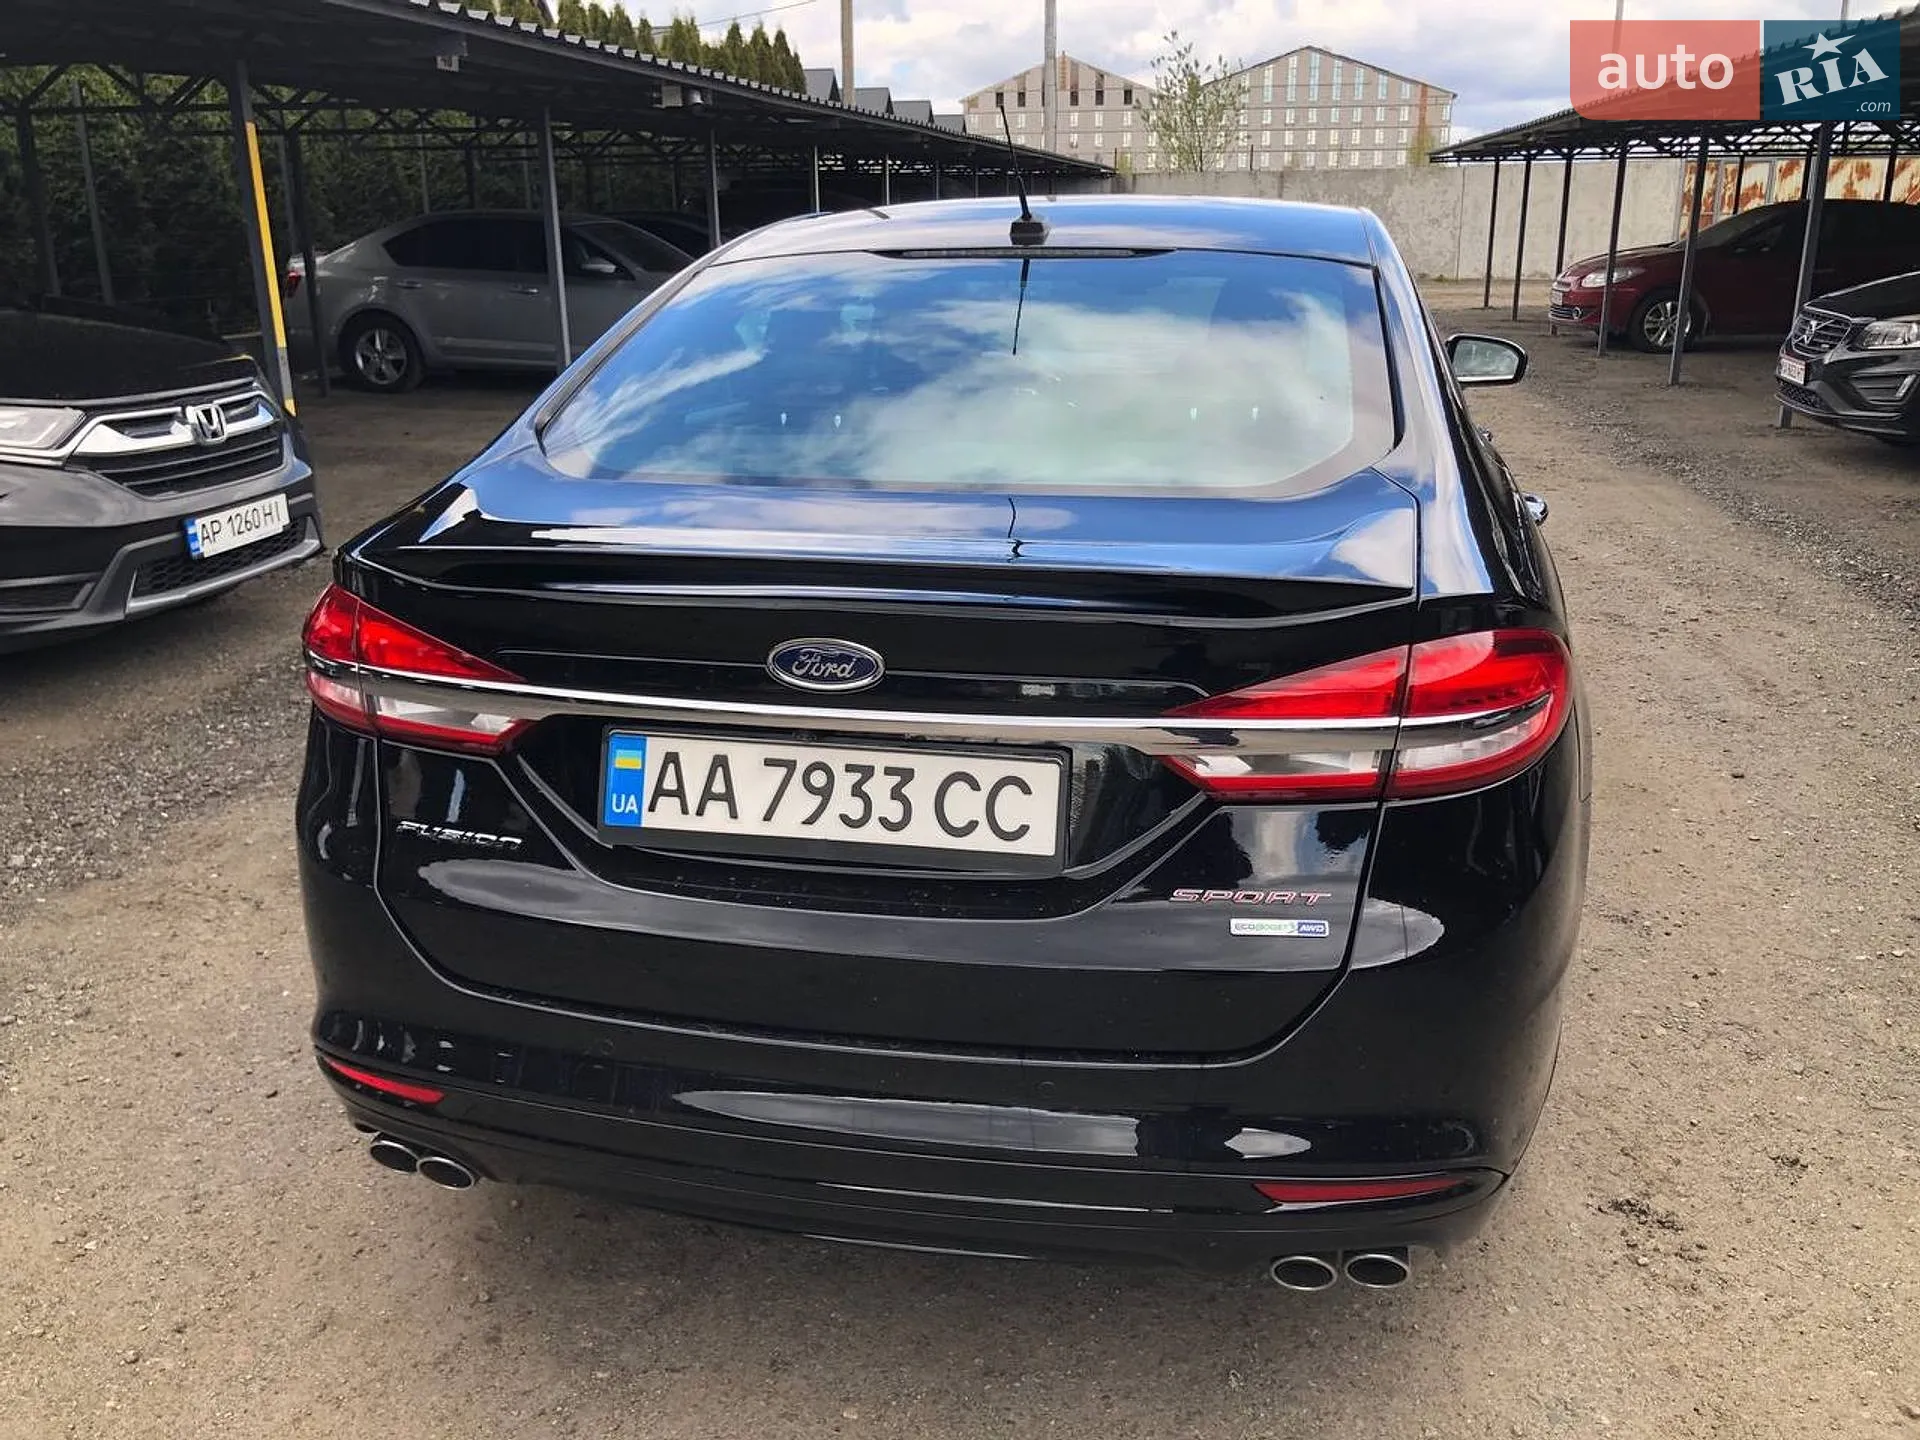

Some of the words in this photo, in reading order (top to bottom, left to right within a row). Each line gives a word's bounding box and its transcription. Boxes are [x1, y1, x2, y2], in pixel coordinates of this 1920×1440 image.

[200, 520, 222, 545] AP
[227, 508, 261, 537] 1260
[262, 501, 281, 525] HI
[791, 648, 858, 678] Ford
[611, 793, 638, 814] UA
[648, 752, 738, 819] AA
[762, 757, 915, 832] 7933
[934, 771, 1032, 841] CC
[396, 820, 523, 849] FUSION
[1169, 888, 1332, 906] SPORT
[1299, 923, 1325, 935] AWD
